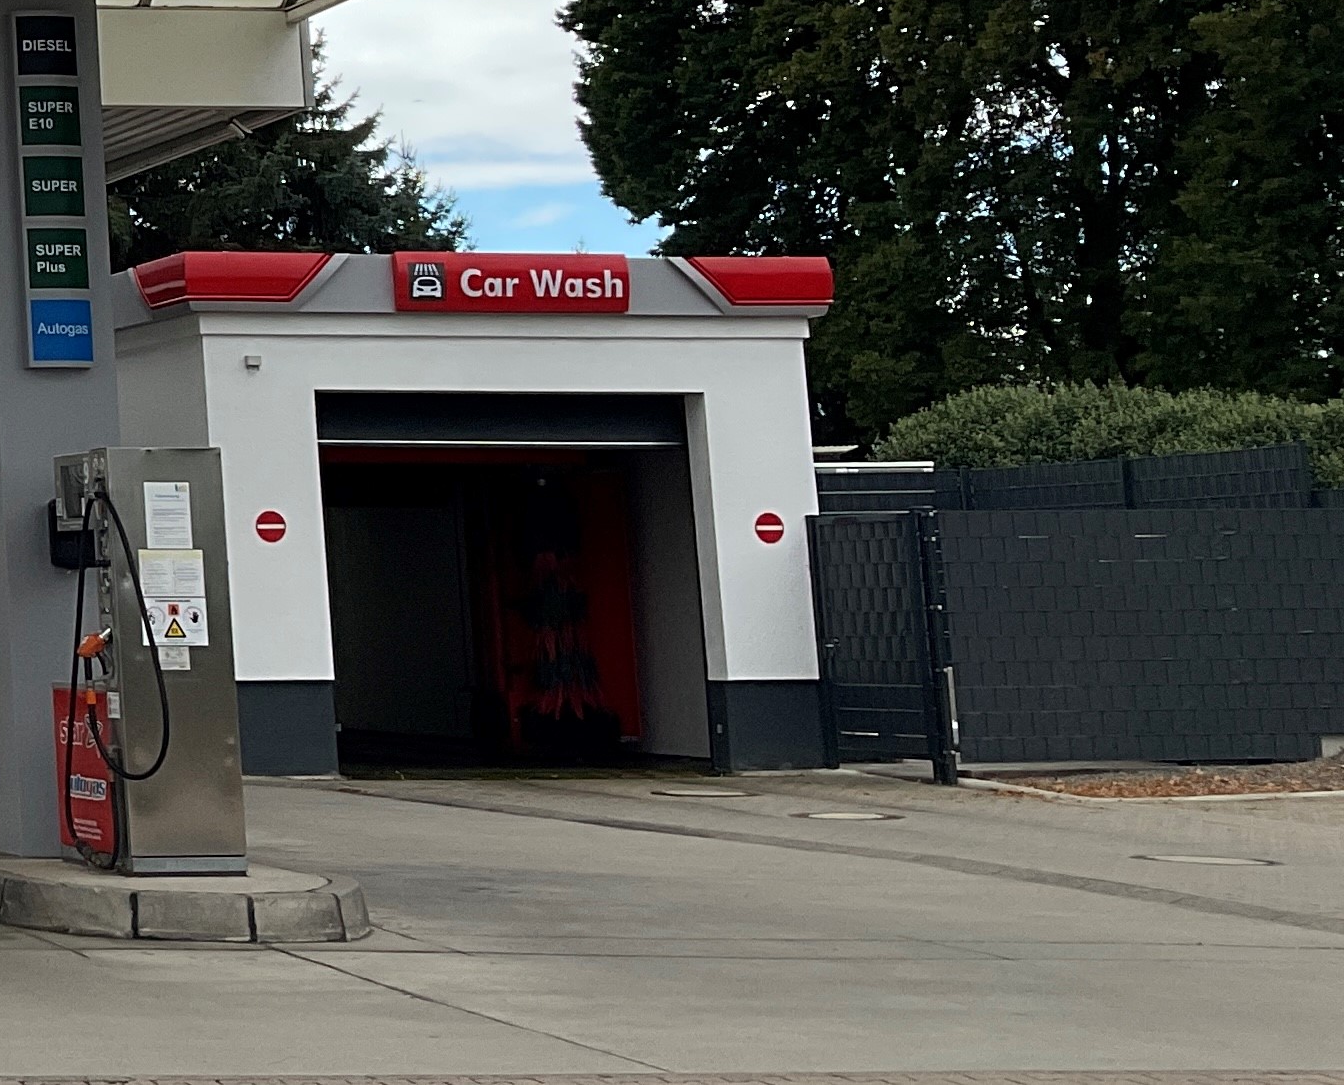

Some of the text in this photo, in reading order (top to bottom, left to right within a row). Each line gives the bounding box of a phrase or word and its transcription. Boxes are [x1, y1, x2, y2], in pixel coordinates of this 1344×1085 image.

[22, 39, 72, 52] DIESEL
[27, 101, 73, 114] SUPER
[28, 117, 54, 130] E10
[31, 179, 78, 192] SUPER
[35, 244, 82, 257] SUPER
[36, 261, 66, 273] Plus
[460, 268, 624, 298] Car Wash
[37, 321, 89, 338] Autogas
